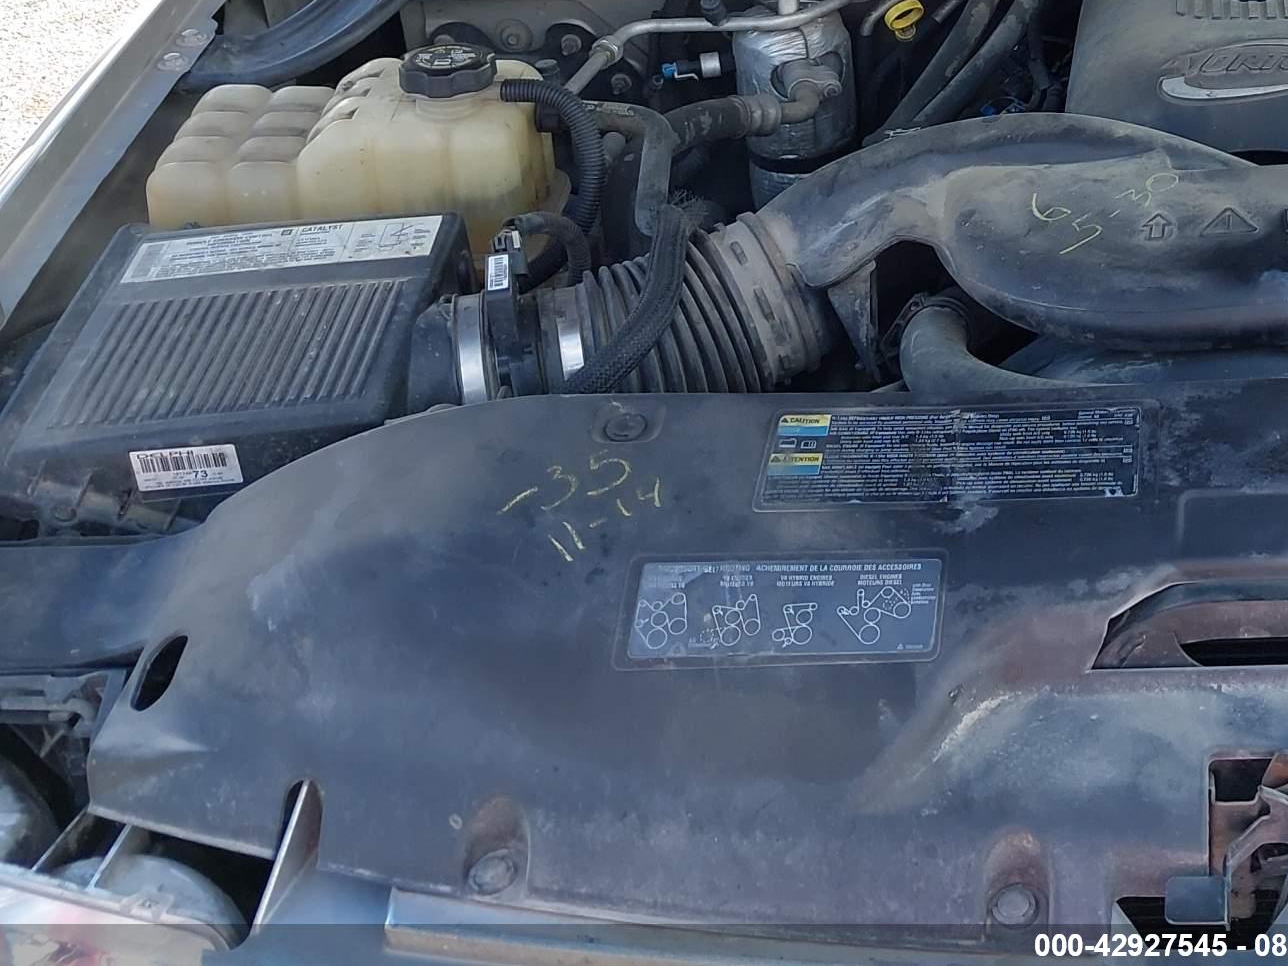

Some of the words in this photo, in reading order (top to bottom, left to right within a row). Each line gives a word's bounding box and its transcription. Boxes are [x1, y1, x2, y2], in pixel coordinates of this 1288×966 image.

[301, 224, 344, 233] CATALYST
[790, 417, 820, 425] CAUTION
[136, 450, 194, 461] DELPHI
[809, 563, 819, 572] DE
[820, 563, 828, 571] LA
[863, 563, 877, 571] DES
[878, 562, 922, 571] ACCESSOIRES
